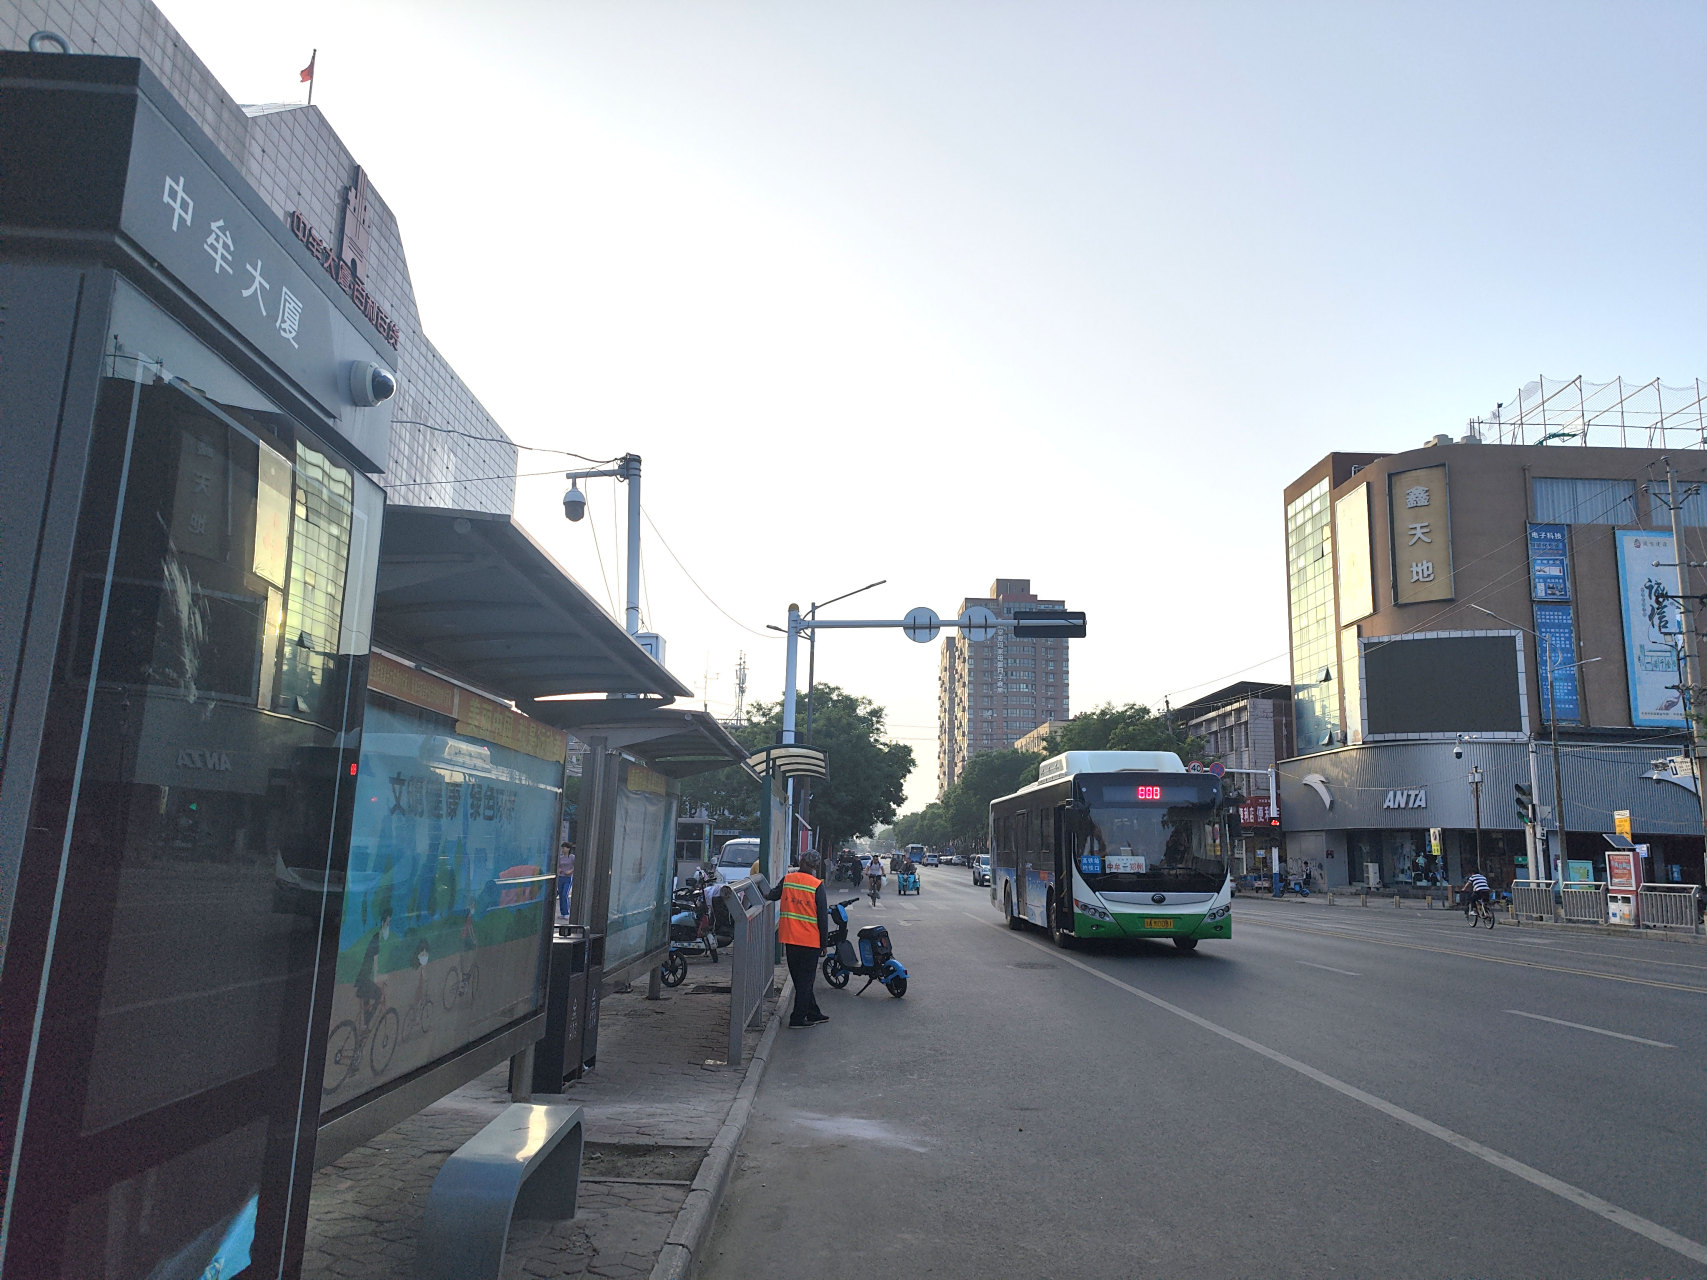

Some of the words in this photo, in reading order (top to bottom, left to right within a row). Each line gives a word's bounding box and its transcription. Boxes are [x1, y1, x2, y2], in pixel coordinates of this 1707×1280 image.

[162, 175, 303, 350] 中牟大厦
[1405, 485, 1435, 583] 鑫天地
[1383, 789, 1427, 809] ANTA
